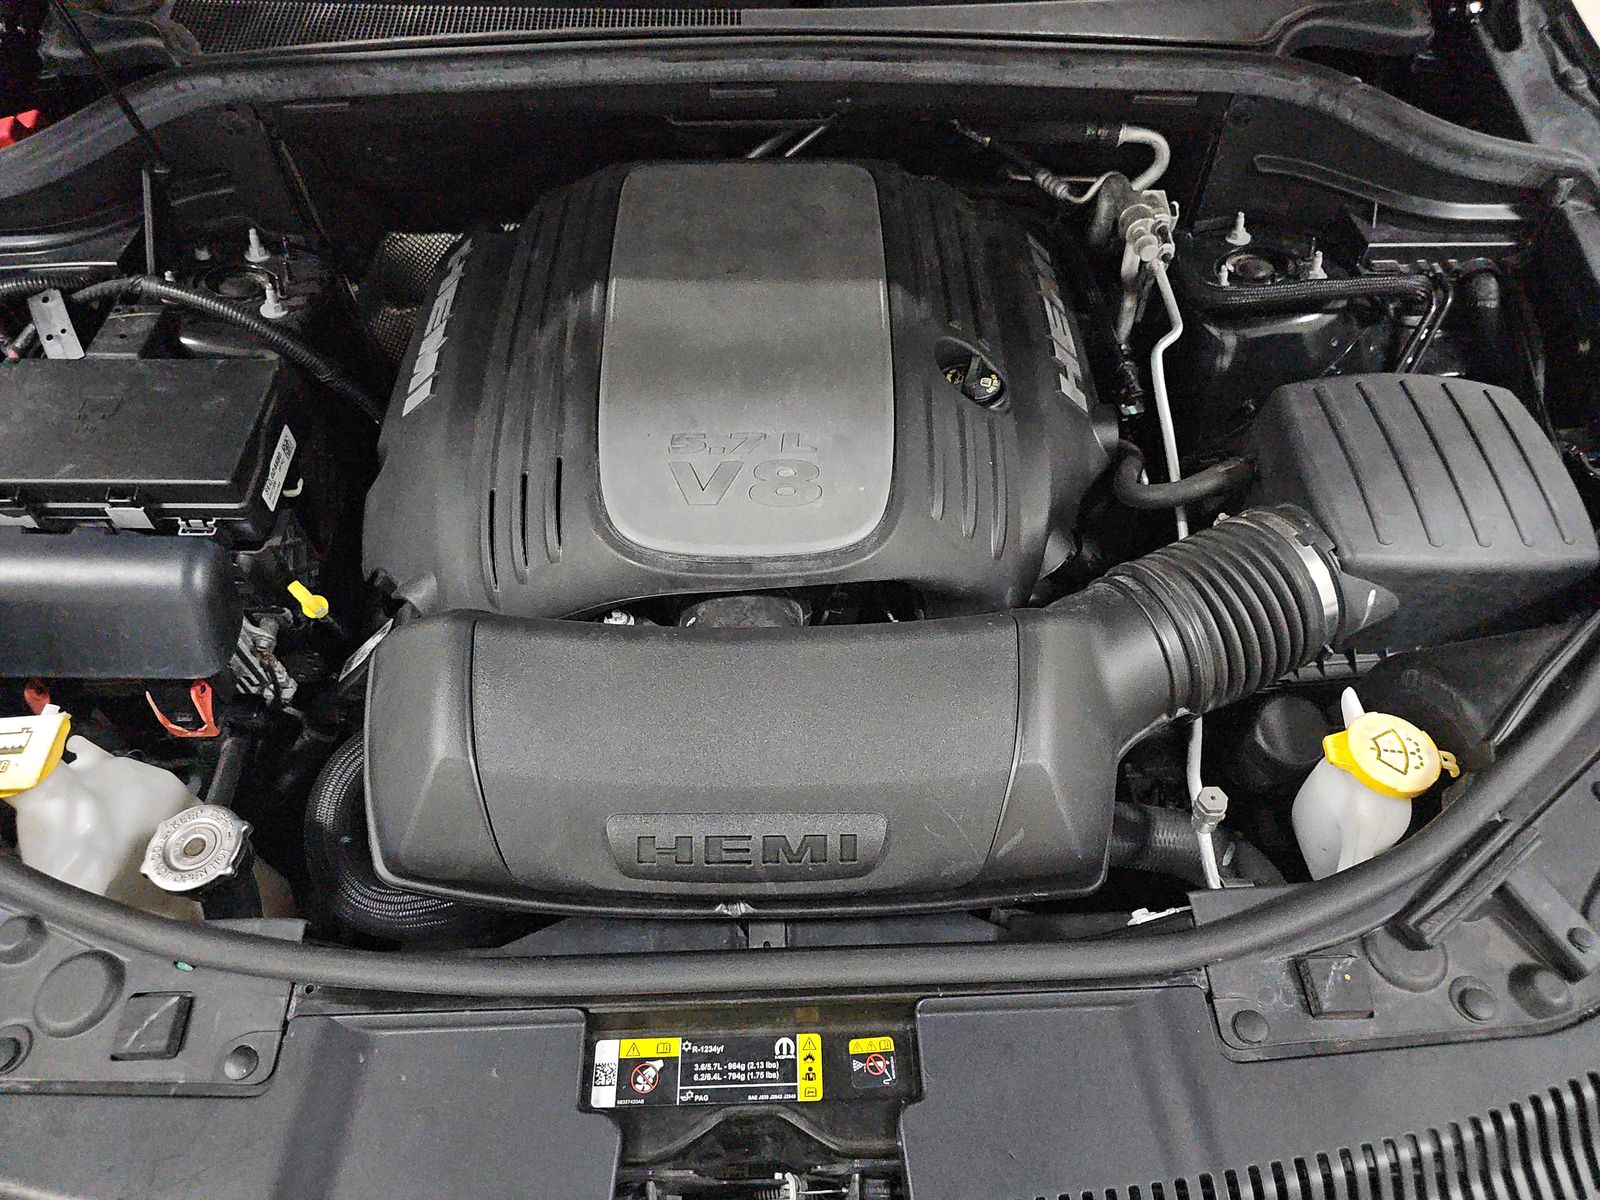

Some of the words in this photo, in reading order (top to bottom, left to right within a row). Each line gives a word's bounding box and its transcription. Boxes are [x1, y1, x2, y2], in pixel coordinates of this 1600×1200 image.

[667, 459, 823, 508] V8
[637, 834, 858, 865] HEMI
[691, 1045, 725, 1054] R-1234yf
[694, 1064, 722, 1072] 3.6/5.7L
[747, 1062, 764, 1070] (2.13
[766, 1061, 780, 1070] lbs)
[693, 1073, 722, 1082] 6.2/6.4L
[747, 1072, 764, 1080] (1.75
[766, 1071, 780, 1080] lbs)
